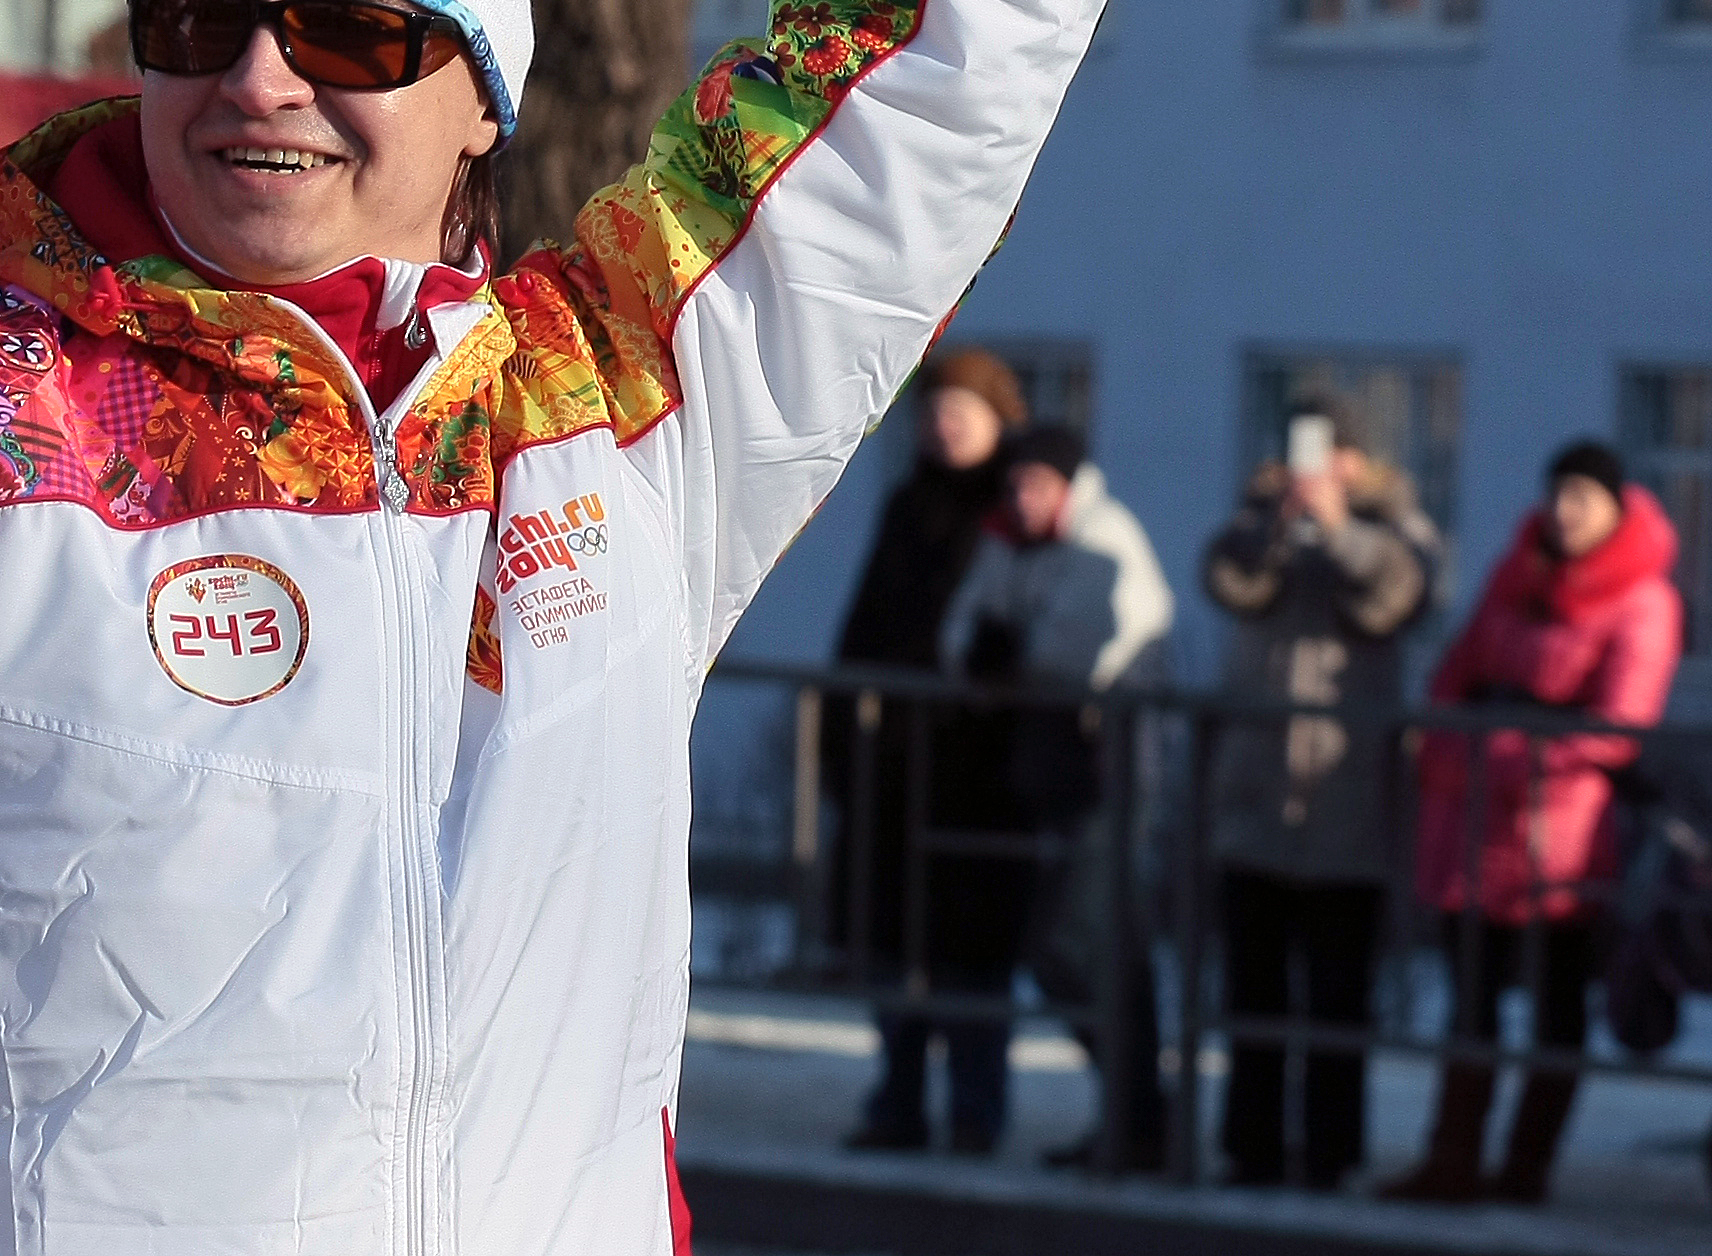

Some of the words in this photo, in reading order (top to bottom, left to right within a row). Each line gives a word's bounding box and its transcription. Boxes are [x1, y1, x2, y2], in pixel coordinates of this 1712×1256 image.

[496, 538, 578, 594] 2014
[509, 577, 595, 616] ЭСТАФЕТА
[169, 608, 281, 656] 243
[531, 626, 569, 649] ОГНЯ
